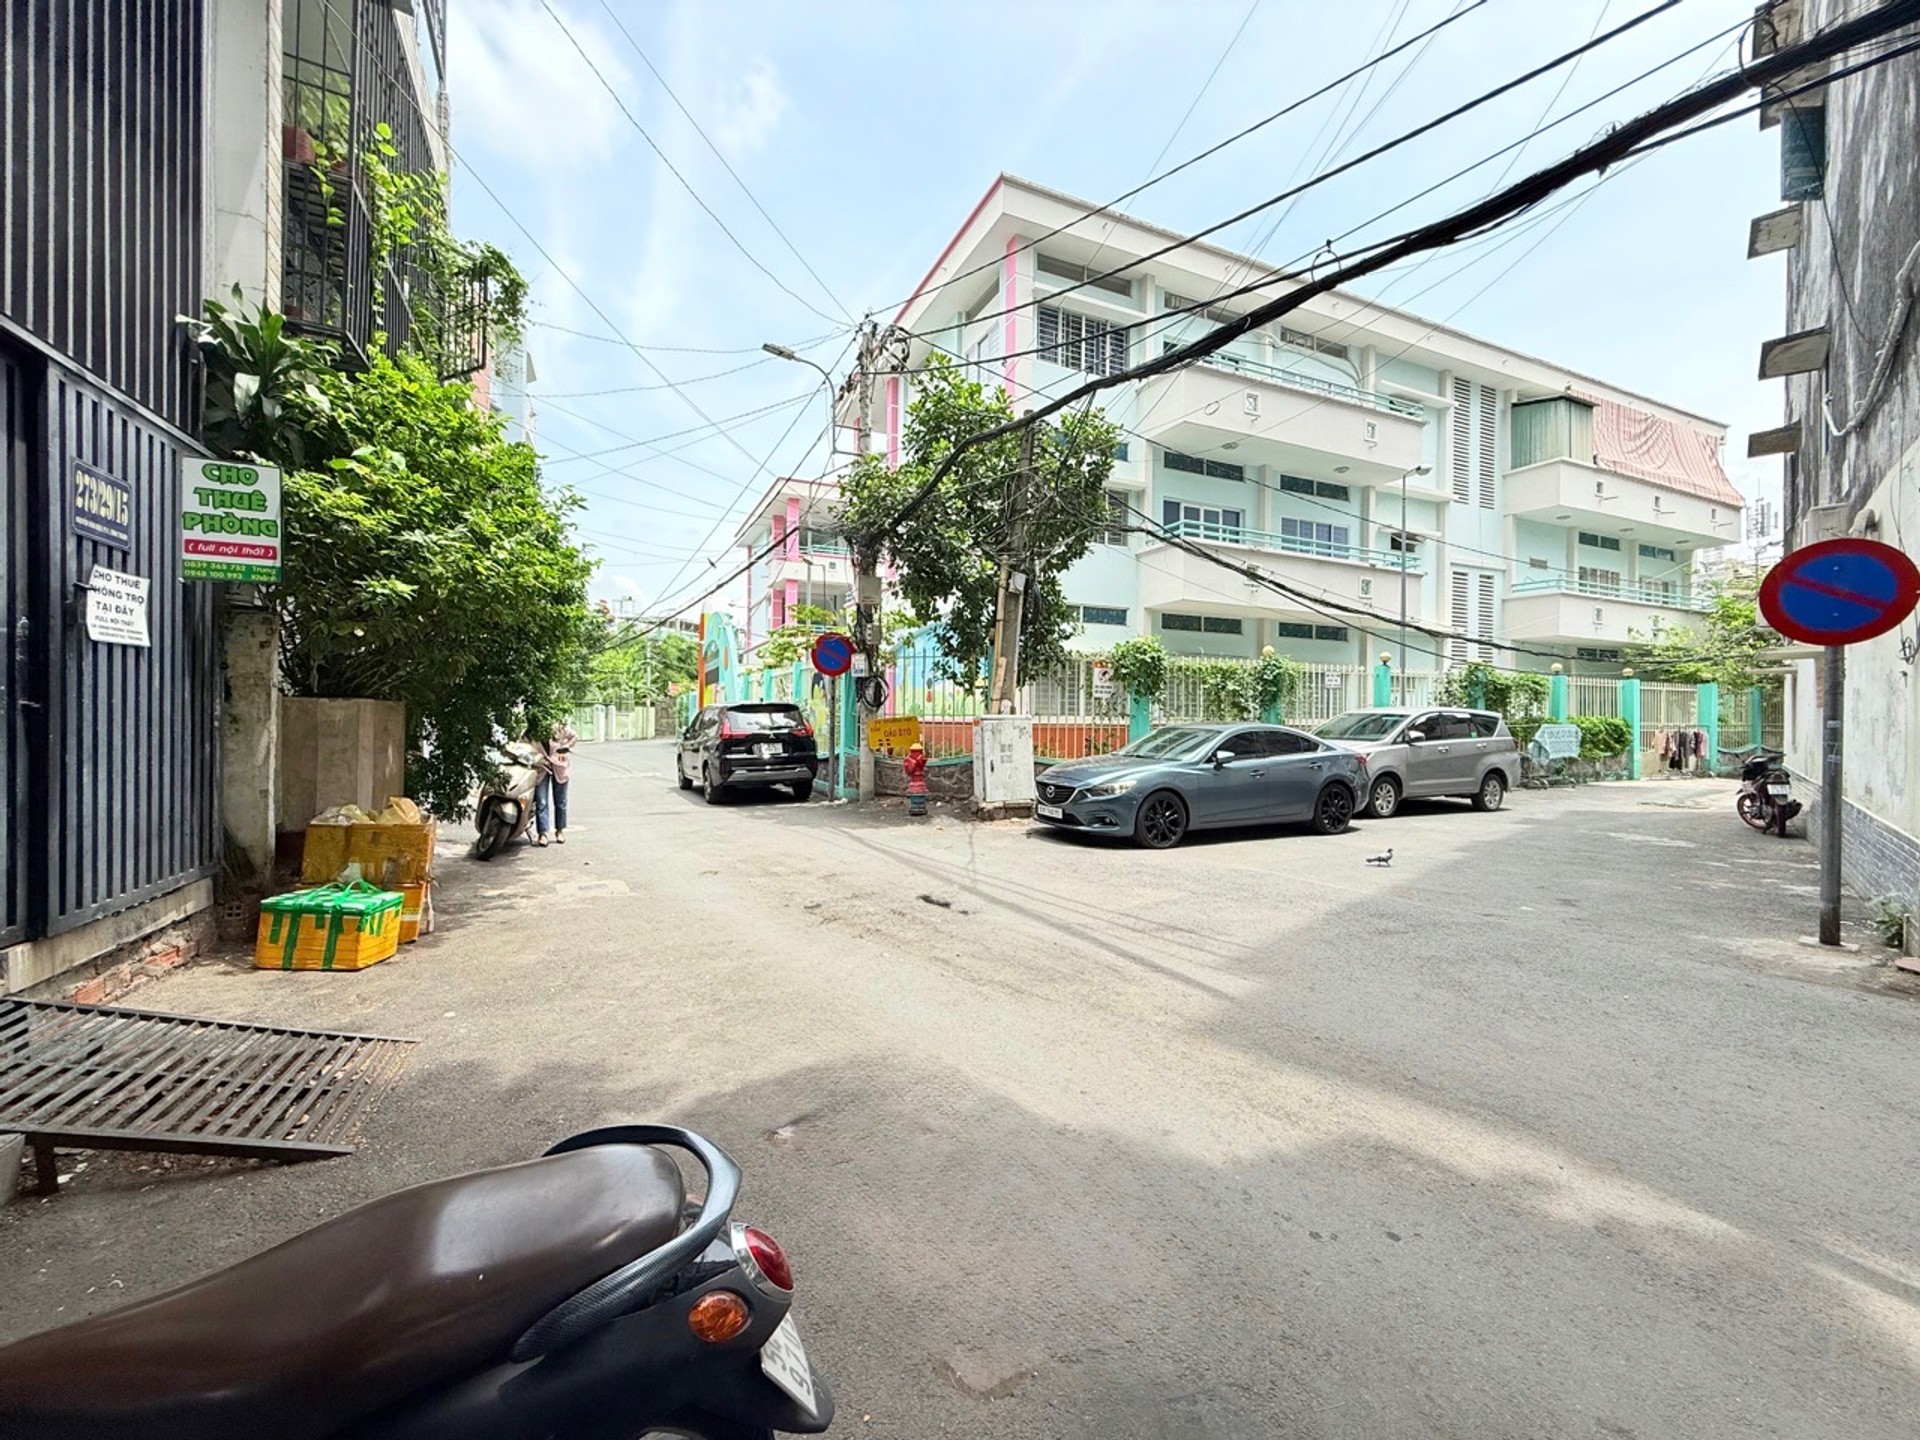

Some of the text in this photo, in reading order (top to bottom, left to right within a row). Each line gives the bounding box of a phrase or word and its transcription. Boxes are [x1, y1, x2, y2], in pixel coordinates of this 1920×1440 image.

[202, 463, 259, 486] CHO
[193, 487, 268, 512] THUÊ
[182, 511, 279, 538] PHÒNG
[197, 542, 216, 552] full
[94, 570, 141, 589] CHO THUÊ
